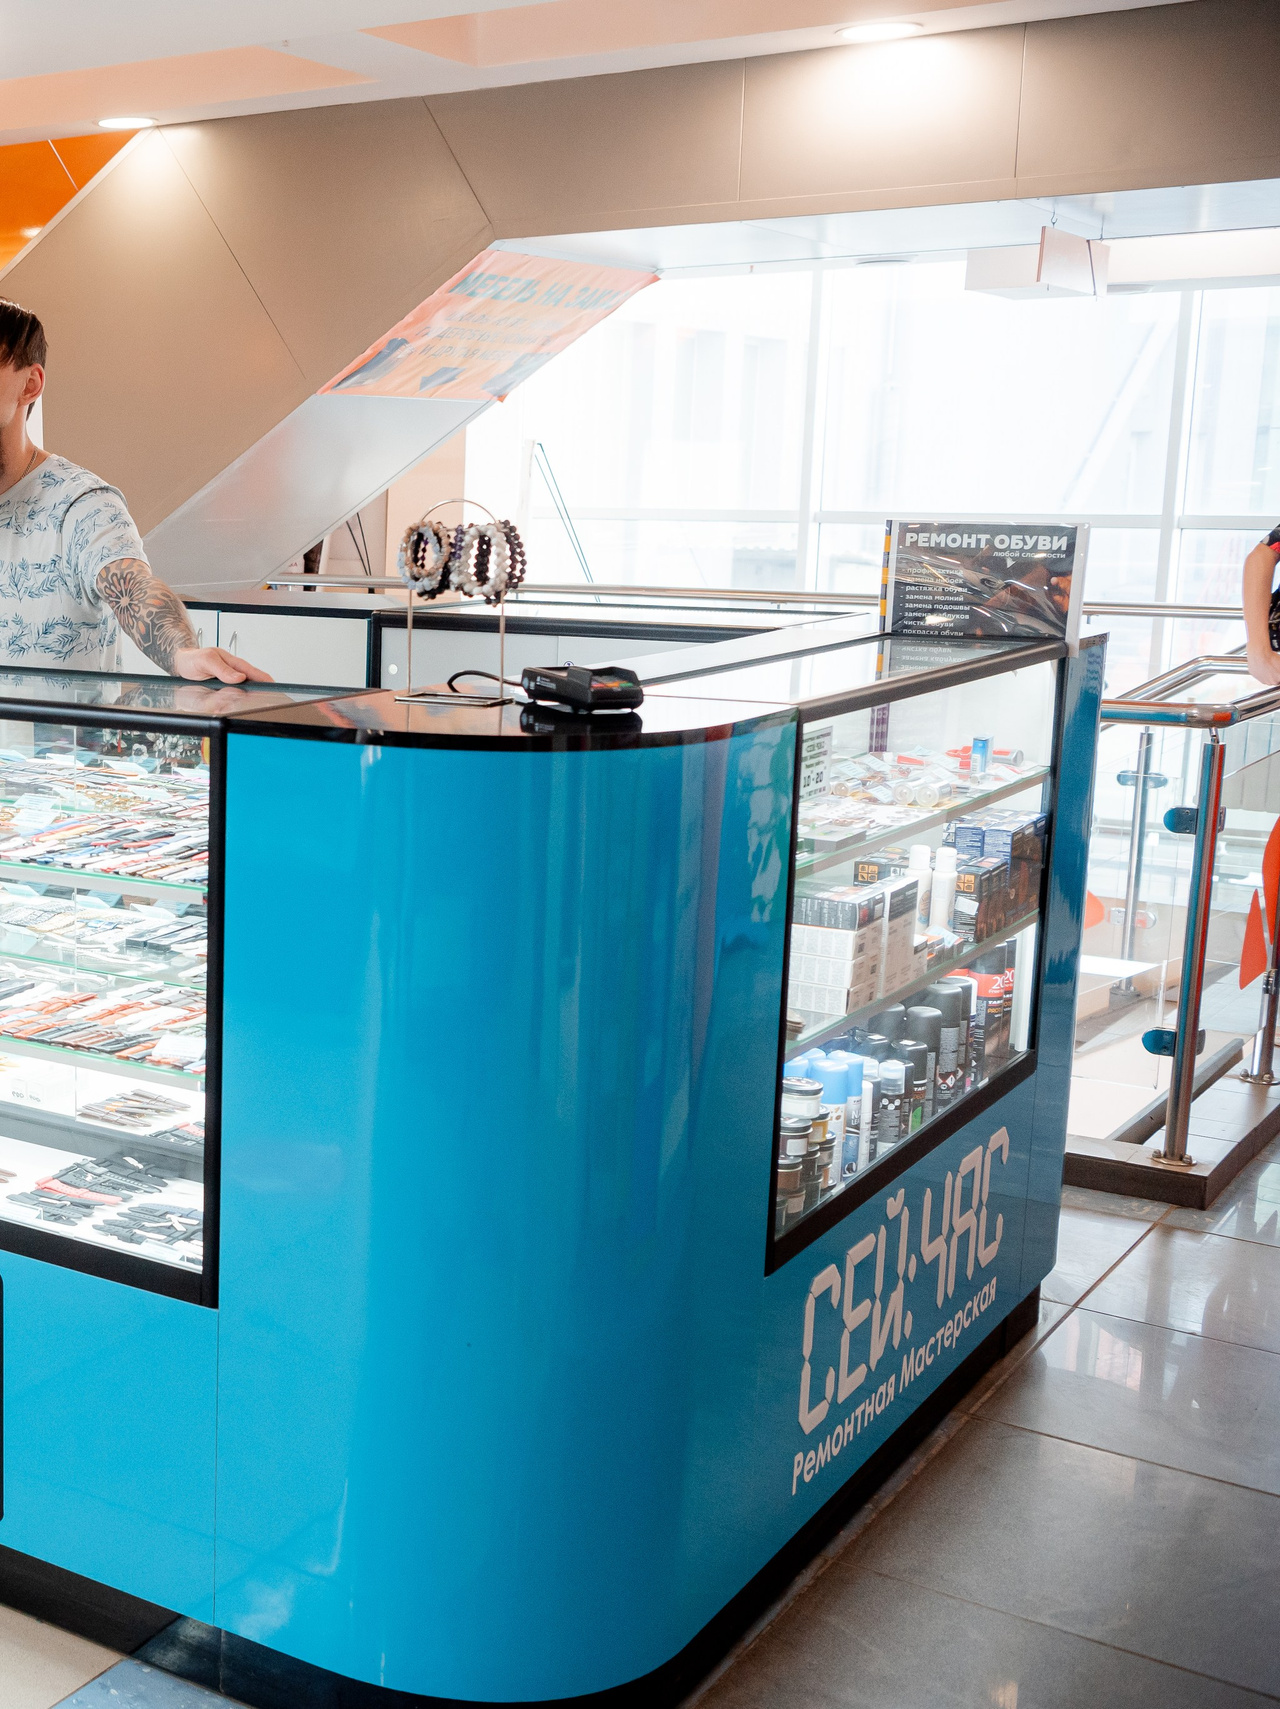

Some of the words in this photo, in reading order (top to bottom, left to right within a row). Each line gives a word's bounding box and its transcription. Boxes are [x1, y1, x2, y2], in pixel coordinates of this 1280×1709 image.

[447, 271, 542, 303] МЕБЕЛЬ
[535, 283, 571, 308] НА
[904, 532, 991, 548] РЕМОНТ
[993, 533, 1068, 551] ОБУВИ
[907, 567, 964, 577] профиактика
[791, 1375, 896, 1495] Ремонтная
[898, 1276, 997, 1394] Мастерская
